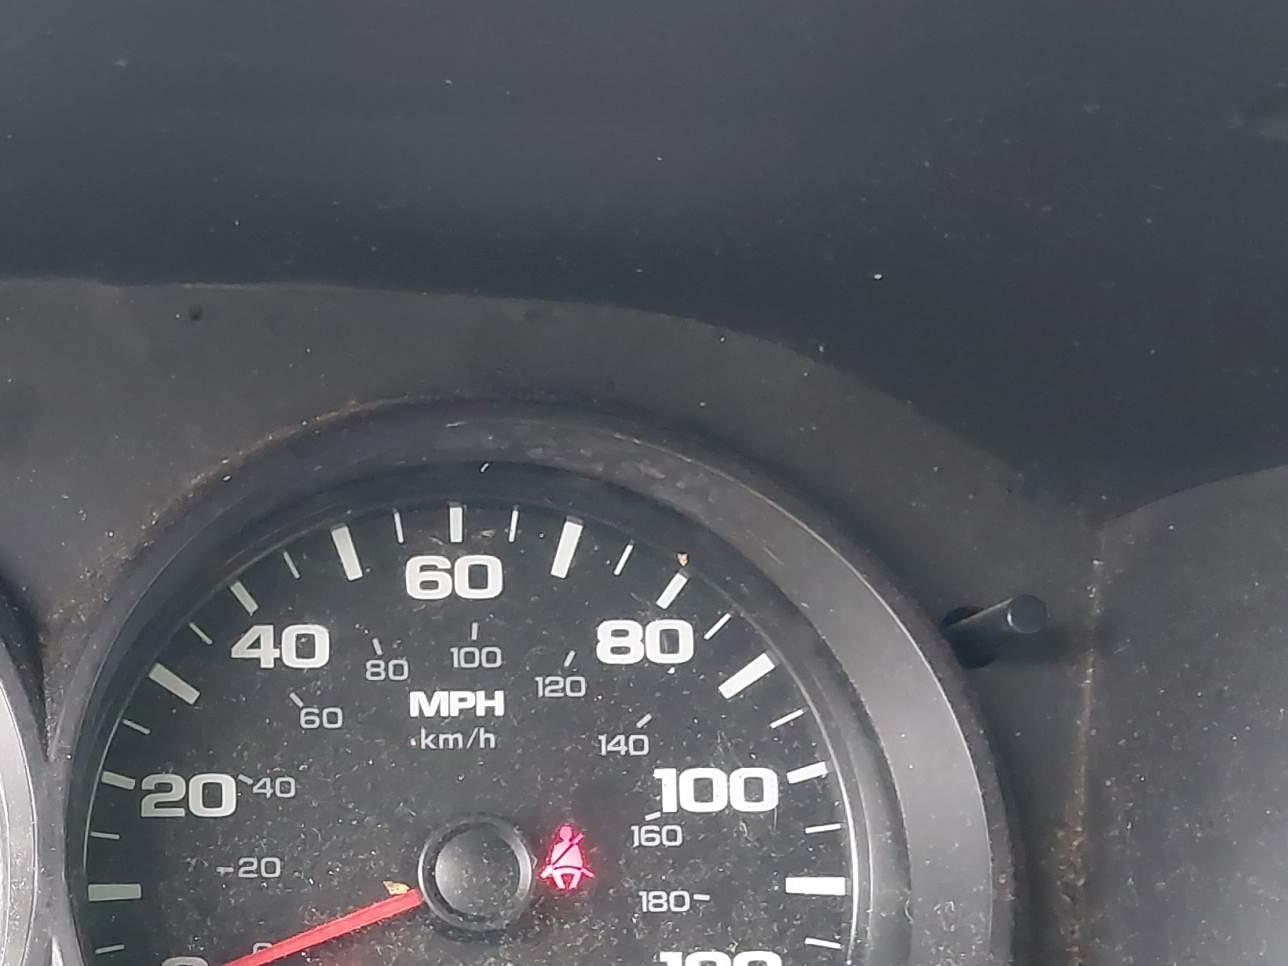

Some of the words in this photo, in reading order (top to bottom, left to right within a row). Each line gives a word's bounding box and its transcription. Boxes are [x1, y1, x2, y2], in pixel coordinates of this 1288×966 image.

[405, 555, 504, 600] 60
[231, 624, 330, 669] 40
[596, 619, 694, 664] 80
[450, 646, 502, 668] 100
[365, 659, 409, 681] 80
[534, 676, 587, 698] 120
[409, 690, 505, 717] MPH
[299, 707, 343, 729] 60
[419, 727, 496, 749] km/h
[598, 734, 649, 756] 140
[140, 773, 237, 818] 20
[252, 777, 296, 799] 40
[653, 767, 779, 813] 100
[630, 825, 683, 847] 160
[237, 857, 281, 879] 20
[638, 890, 691, 912] 180
